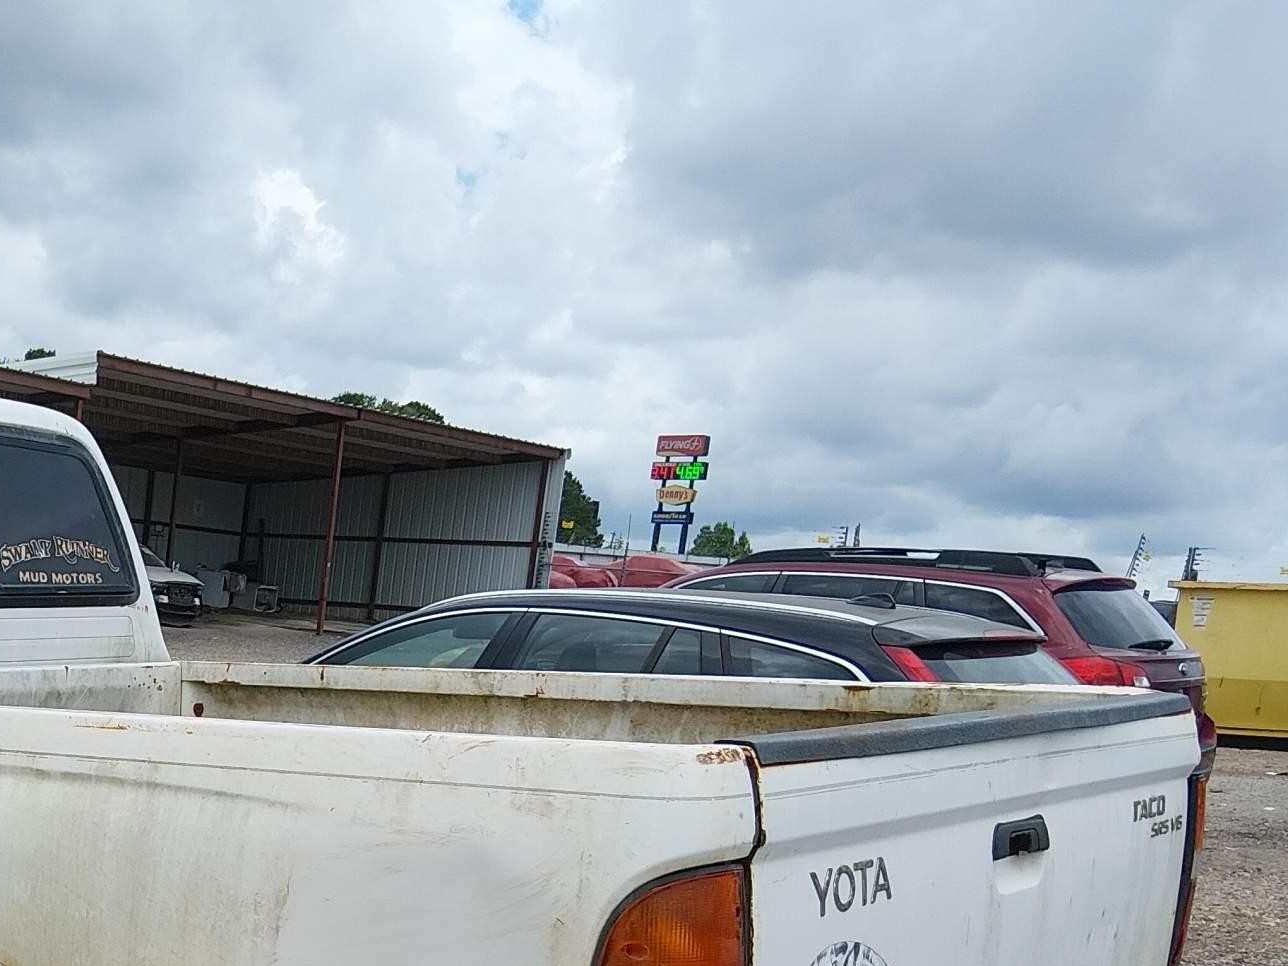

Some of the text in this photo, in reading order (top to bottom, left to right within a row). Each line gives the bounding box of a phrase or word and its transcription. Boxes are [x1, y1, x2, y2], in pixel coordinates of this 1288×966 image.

[659, 438, 690, 450] FLYING
[659, 489, 689, 500] Denny's
[53, 536, 120, 573] RUNNER
[19, 571, 103, 584] MUD MOTORS
[1133, 795, 1166, 822] TACO
[809, 856, 892, 917] YOTA
